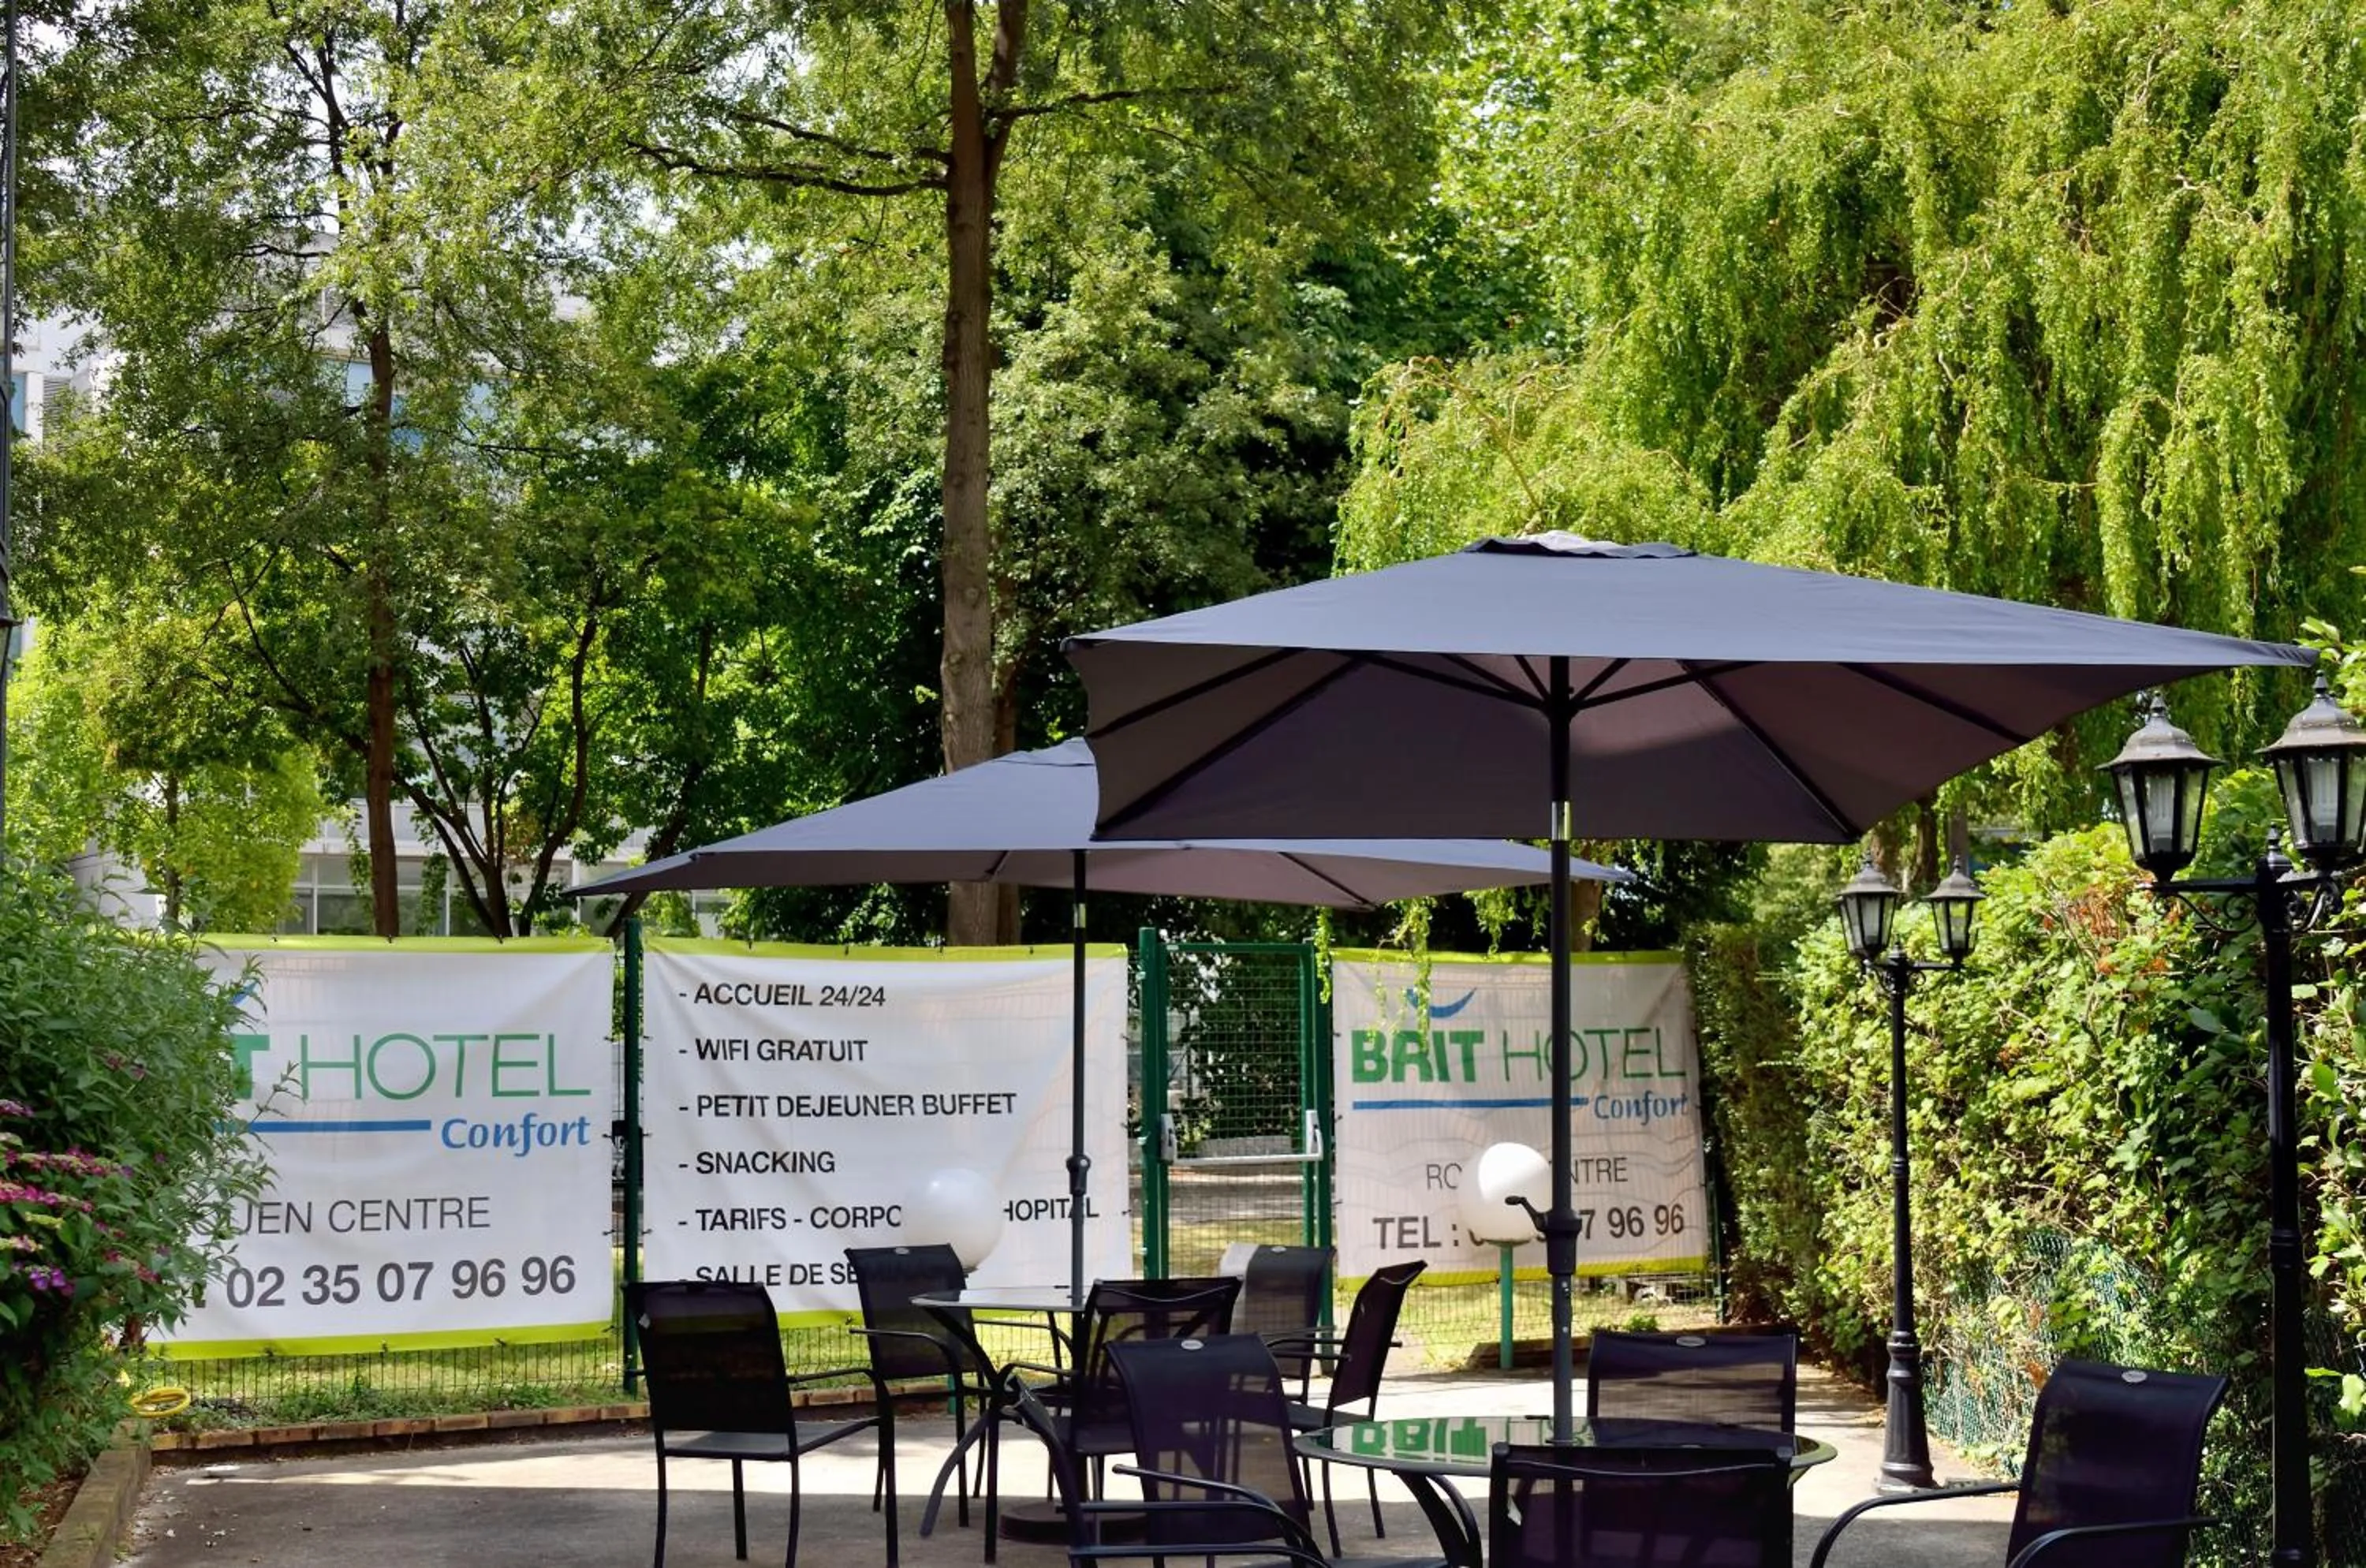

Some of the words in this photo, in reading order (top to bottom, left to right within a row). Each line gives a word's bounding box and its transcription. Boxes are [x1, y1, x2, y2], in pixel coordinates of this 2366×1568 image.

[694, 983, 812, 1007] ACCUEIL
[819, 985, 886, 1008] 24/24
[300, 1033, 592, 1099] HOTEL
[695, 1037, 748, 1062] WIFI
[756, 1038, 868, 1062] GRATUIT
[1351, 1028, 1485, 1084] BRIT
[696, 1093, 770, 1118] PETIT
[776, 1094, 915, 1118] DEJEUNER
[921, 1092, 1017, 1115] BUFFET
[1594, 1091, 1689, 1126] Confort
[441, 1112, 591, 1158] Confort
[696, 1151, 836, 1174] SNACKING
[328, 1197, 491, 1233] CENTRE
[695, 1207, 787, 1231] TARIFS
[1003, 1197, 1100, 1222] HOPITL
[1372, 1215, 1442, 1250] TEL
[1607, 1205, 1645, 1239] 96
[1654, 1203, 1685, 1235] 96
[226, 1266, 285, 1309] 02
[302, 1264, 360, 1305] 35
[377, 1261, 434, 1302] 07
[452, 1258, 506, 1299] 96
[521, 1255, 576, 1295] 96
[789, 1264, 824, 1286] DE
